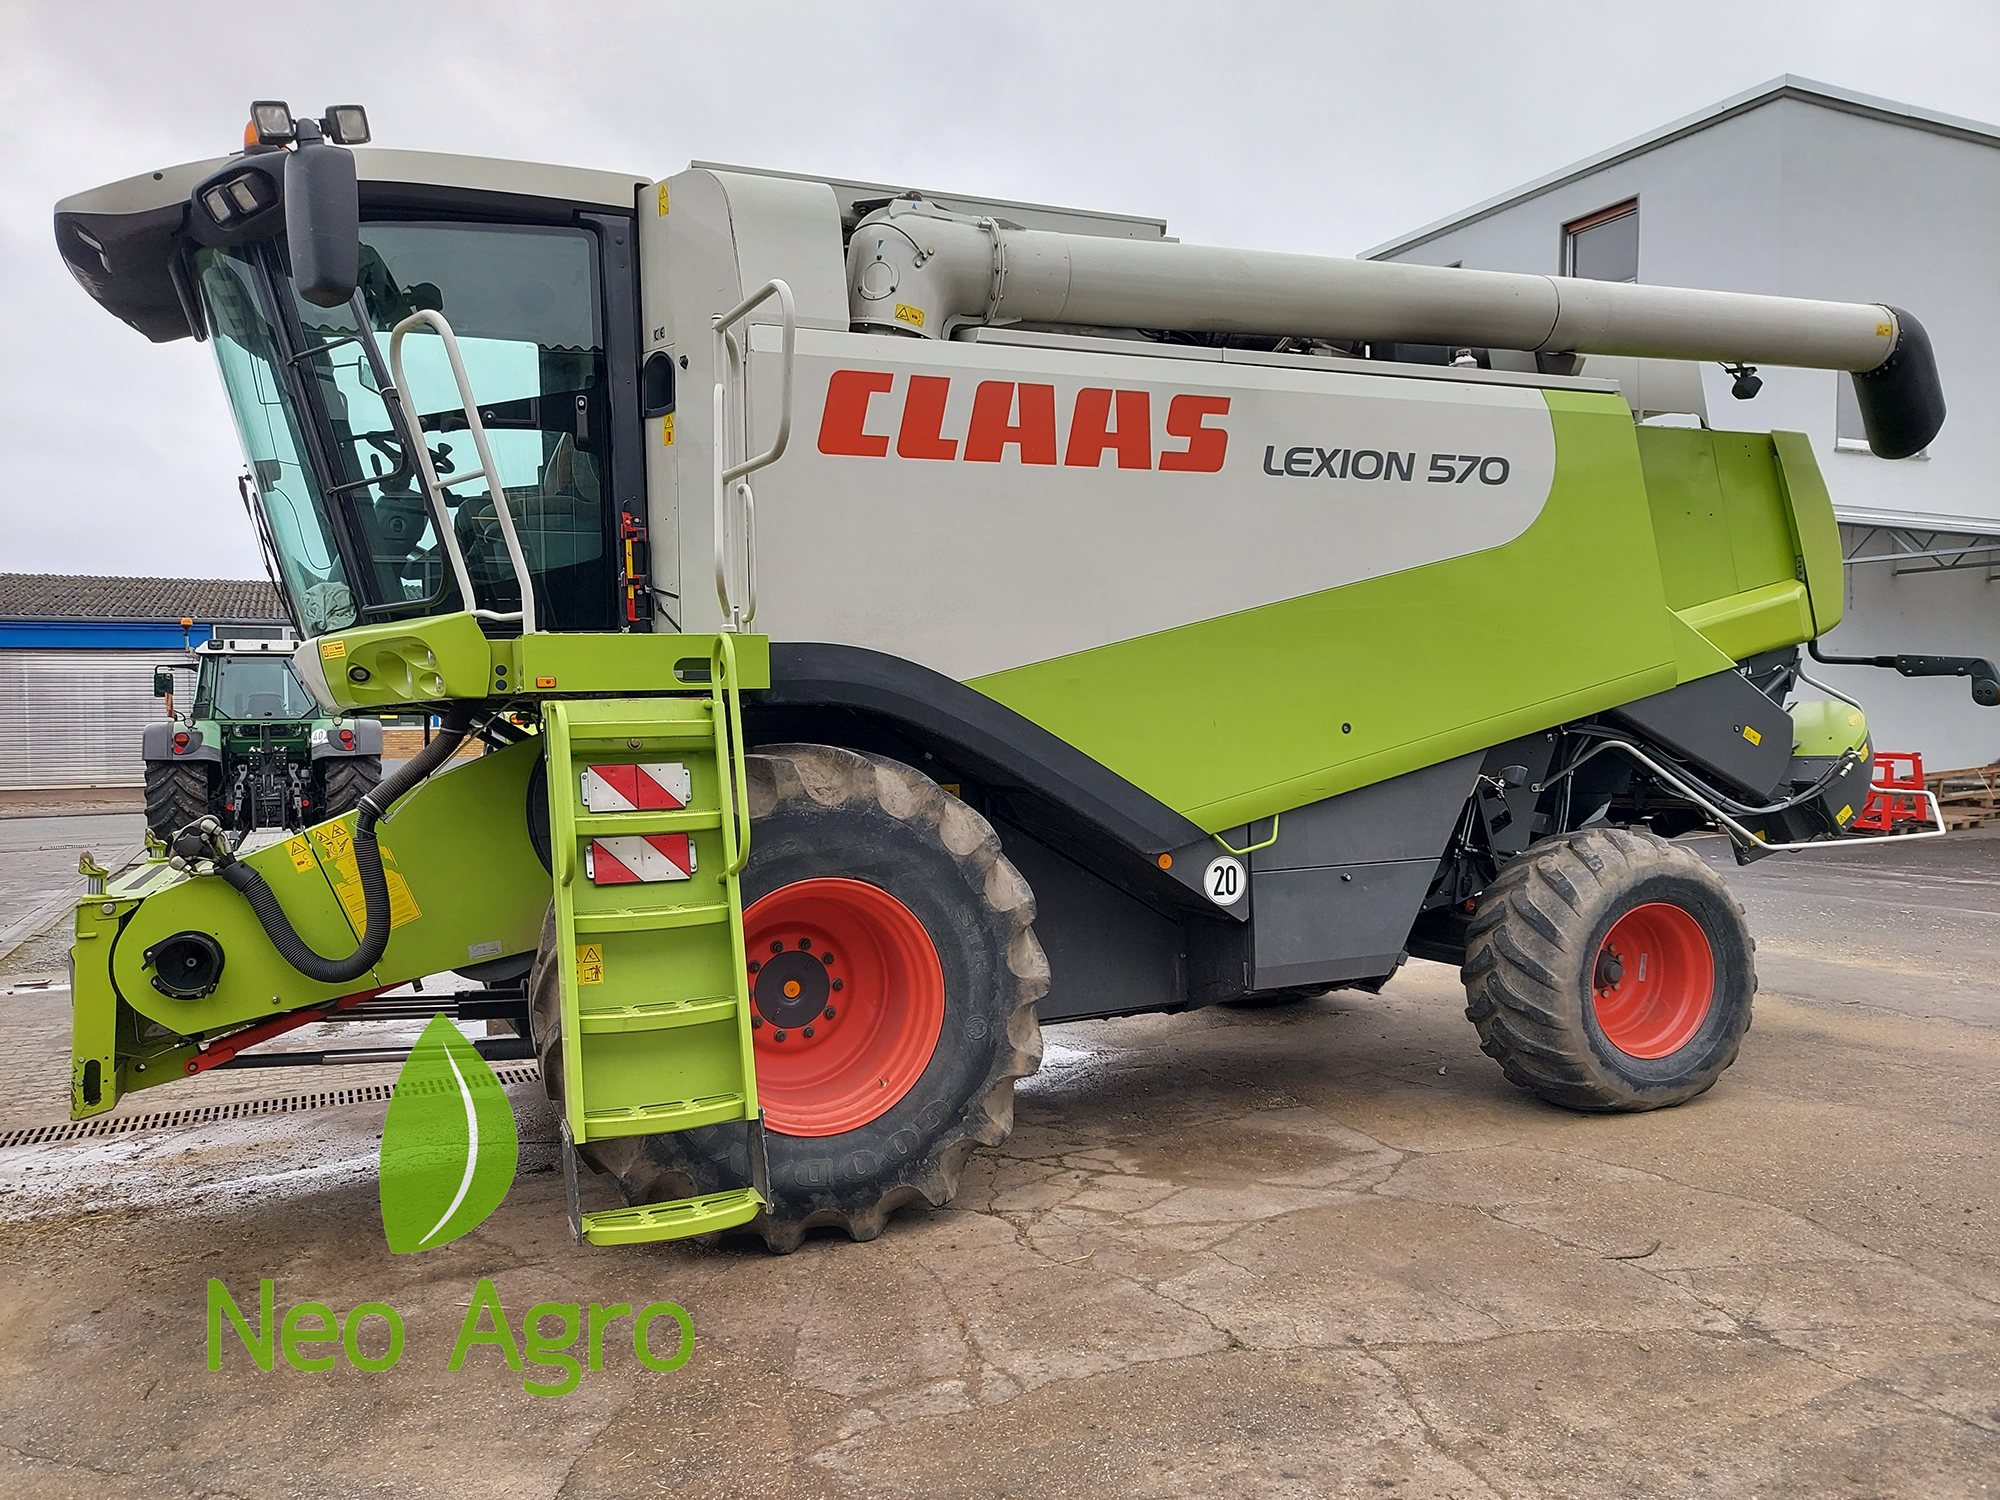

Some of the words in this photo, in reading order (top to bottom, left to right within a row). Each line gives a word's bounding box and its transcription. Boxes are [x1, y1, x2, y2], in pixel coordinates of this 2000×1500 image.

[817, 369, 1232, 474] CLAAS
[1263, 445, 1416, 482] LEXION
[1427, 453, 1510, 486] 570
[1213, 865, 1238, 896] 20
